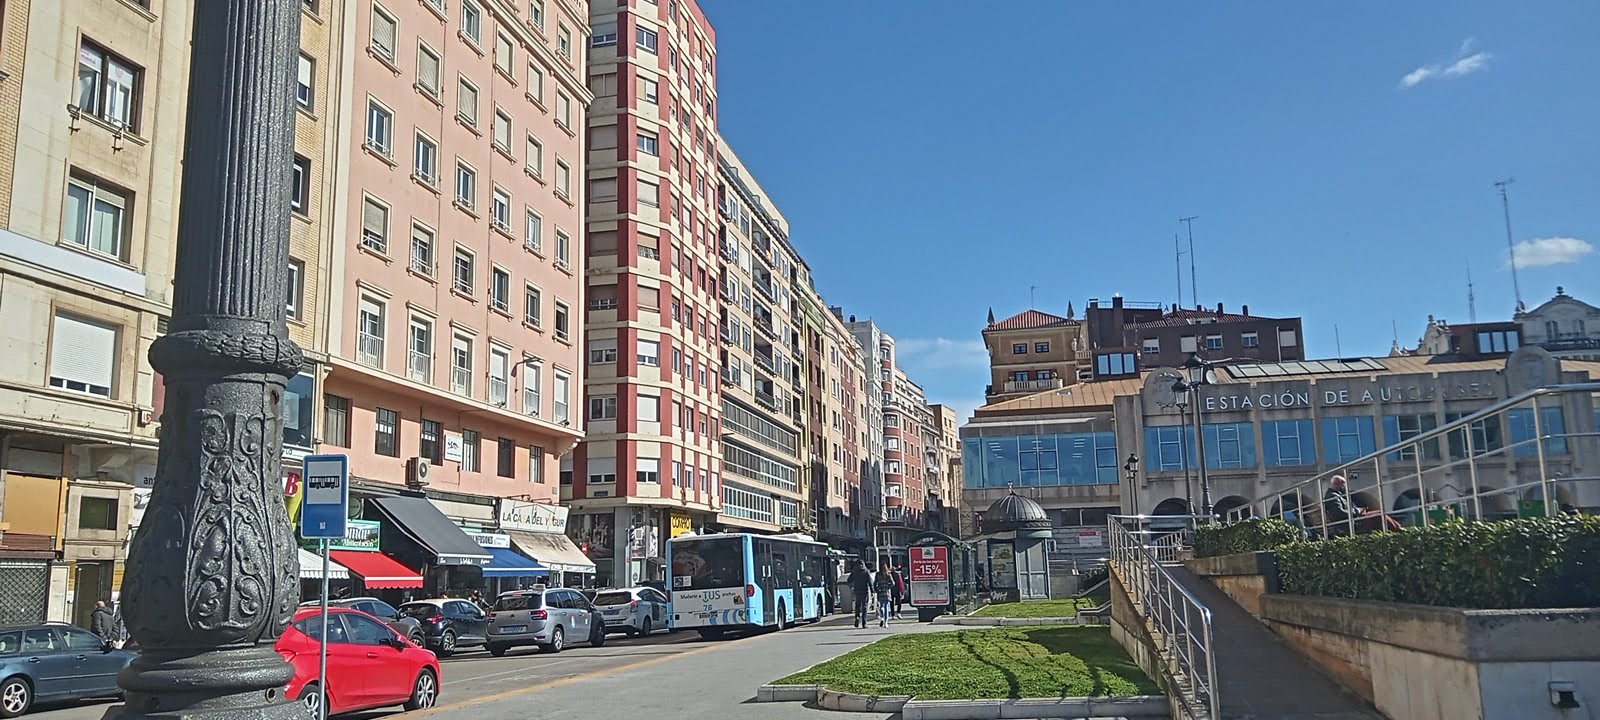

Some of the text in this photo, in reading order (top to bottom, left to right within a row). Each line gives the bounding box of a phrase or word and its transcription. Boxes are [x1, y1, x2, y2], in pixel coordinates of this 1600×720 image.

[1206, 389, 1309, 410] ESTACIÓN
[1325, 390, 1349, 404] DE
[502, 512, 512, 522] LA
[545, 516, 565, 528] YGUR
[915, 564, 942, 575] -15%
[702, 590, 721, 600] TUS
